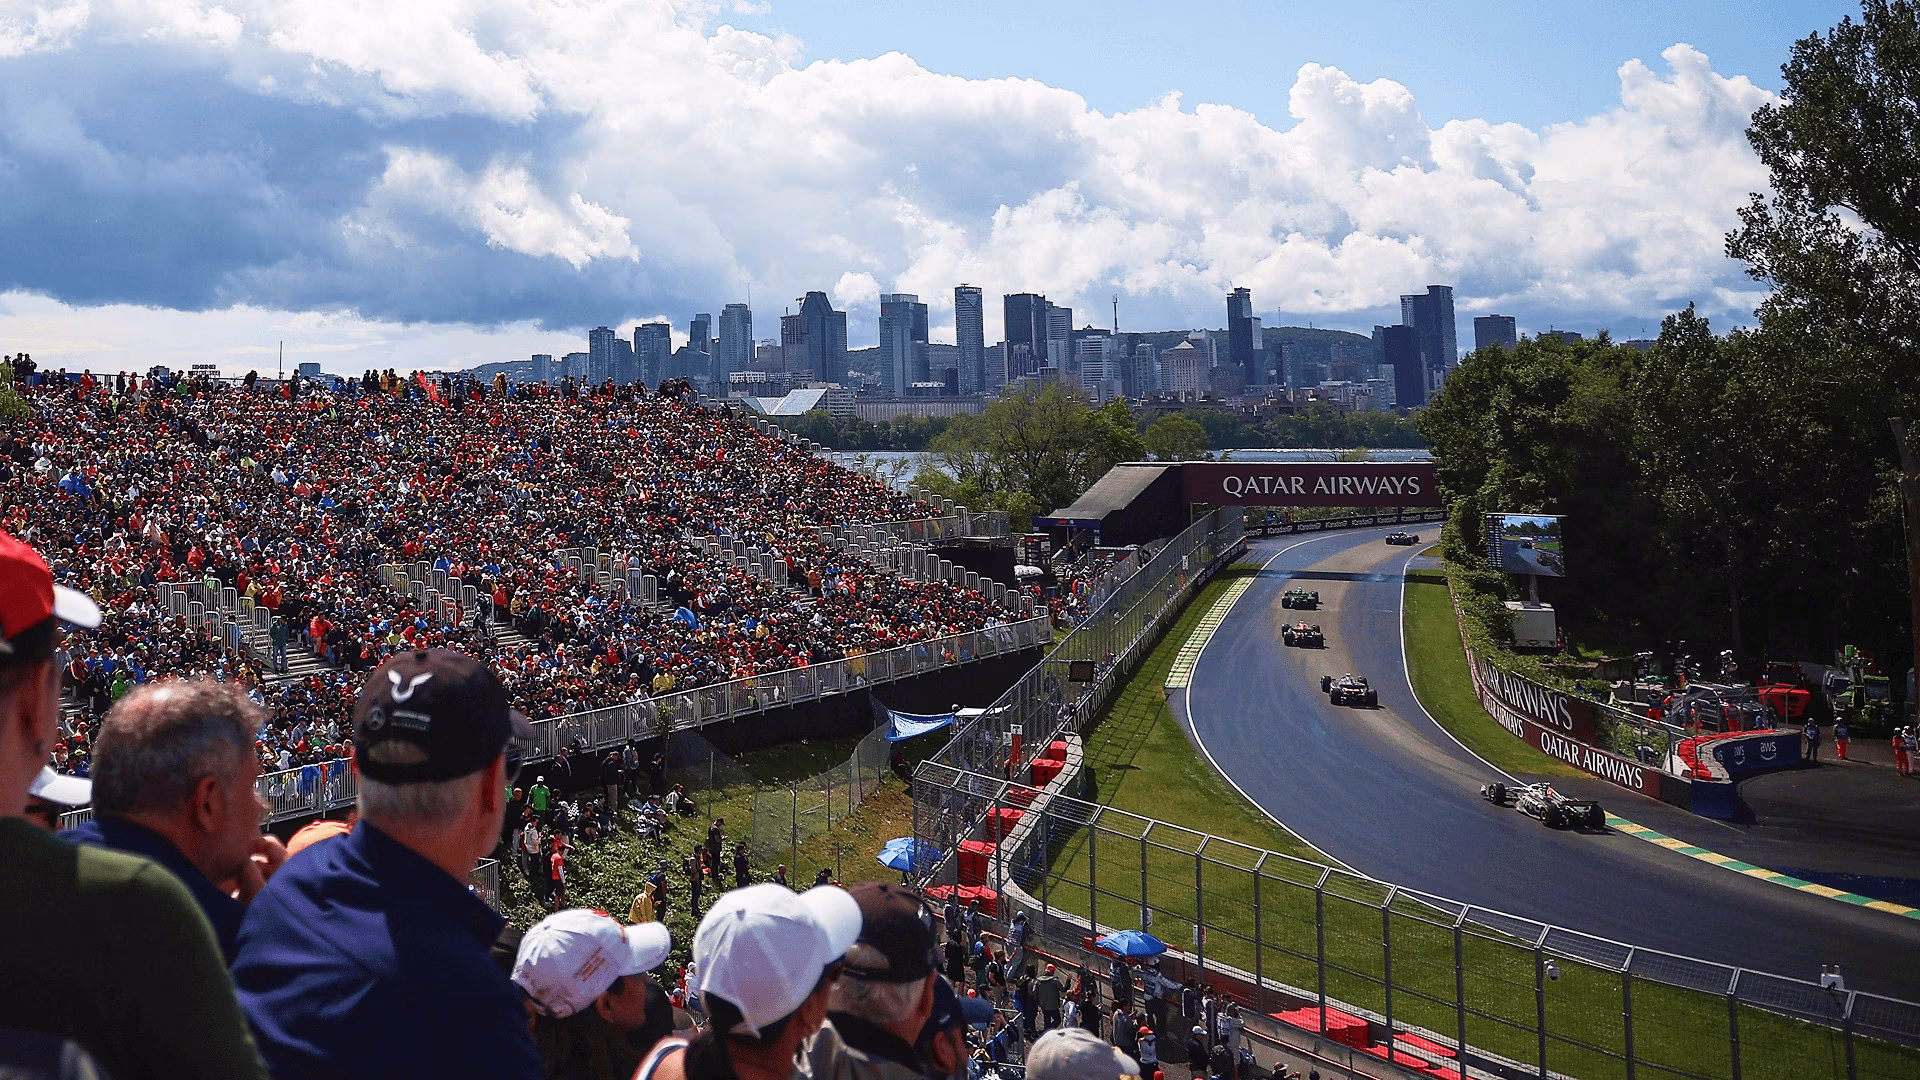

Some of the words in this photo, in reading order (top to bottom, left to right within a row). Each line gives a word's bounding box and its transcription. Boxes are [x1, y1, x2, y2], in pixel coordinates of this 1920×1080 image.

[1222, 475, 1306, 498] QATAR
[1313, 475, 1421, 495] AIRWAYS
[1502, 672, 1573, 731] AIRWAYS
[1496, 703, 1524, 738] AIRWAYS
[1541, 731, 1580, 766] QATAR
[1582, 749, 1644, 789] AIRWAYS
[1760, 741, 1777, 753] aws
